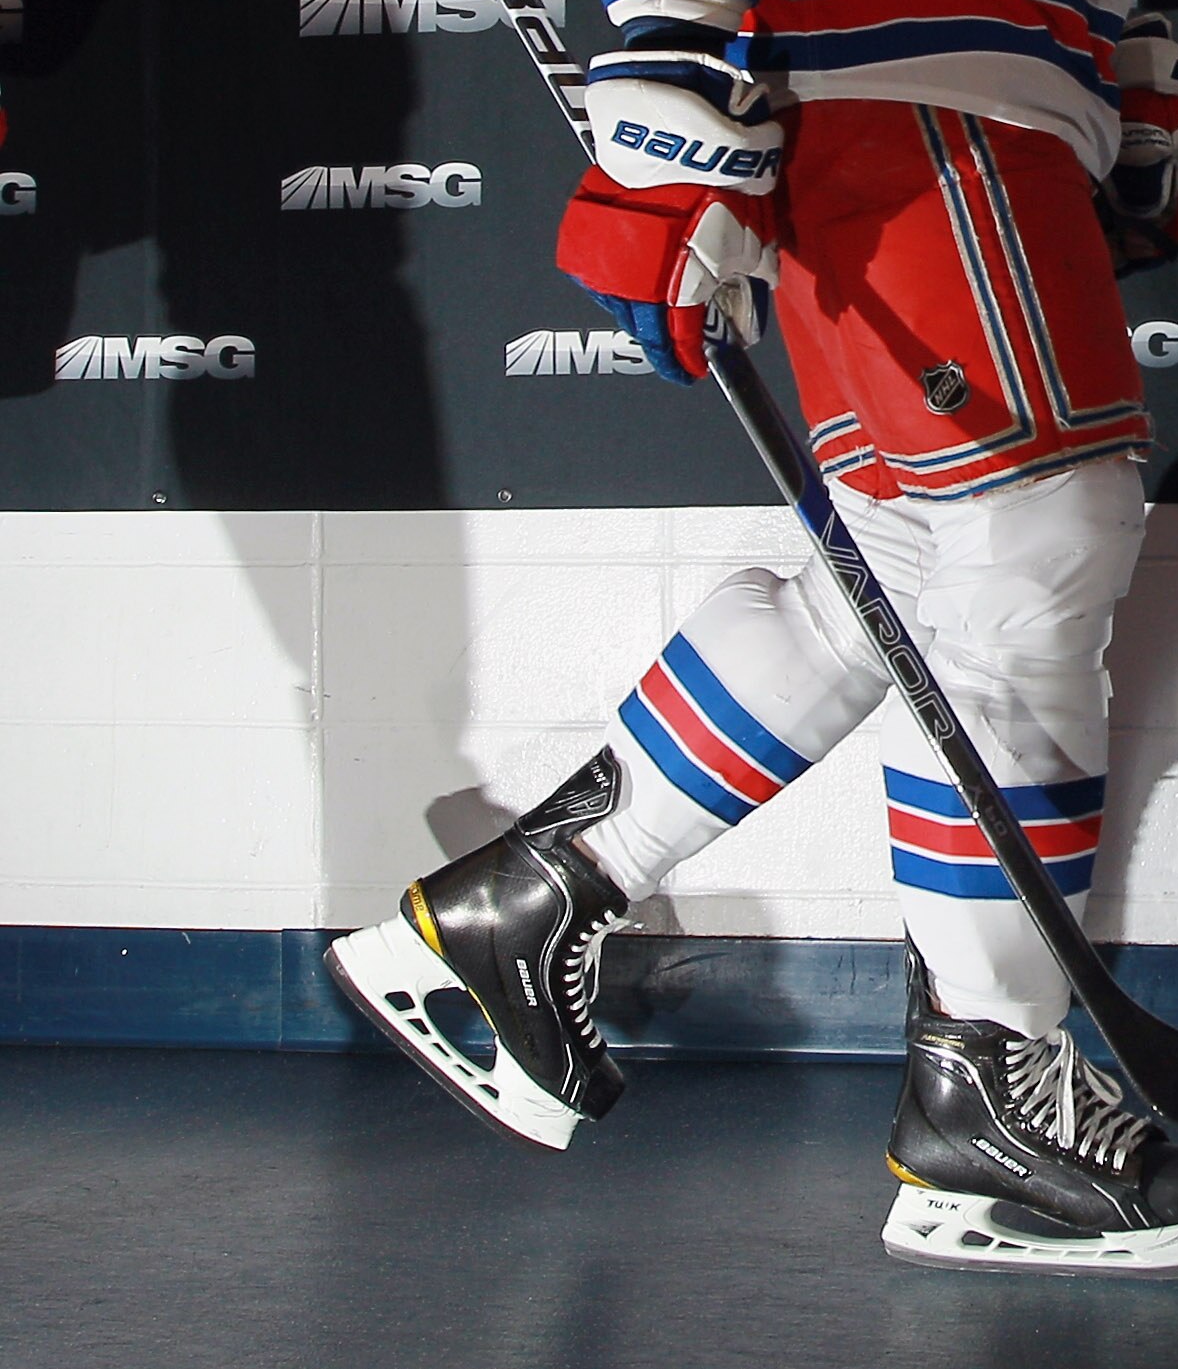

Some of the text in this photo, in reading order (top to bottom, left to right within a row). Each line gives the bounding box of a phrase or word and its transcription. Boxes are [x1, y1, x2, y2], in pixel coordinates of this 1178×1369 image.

[334, 162, 482, 209] MSG
[104, 334, 256, 379] MSG
[820, 510, 956, 750] VAPOR
